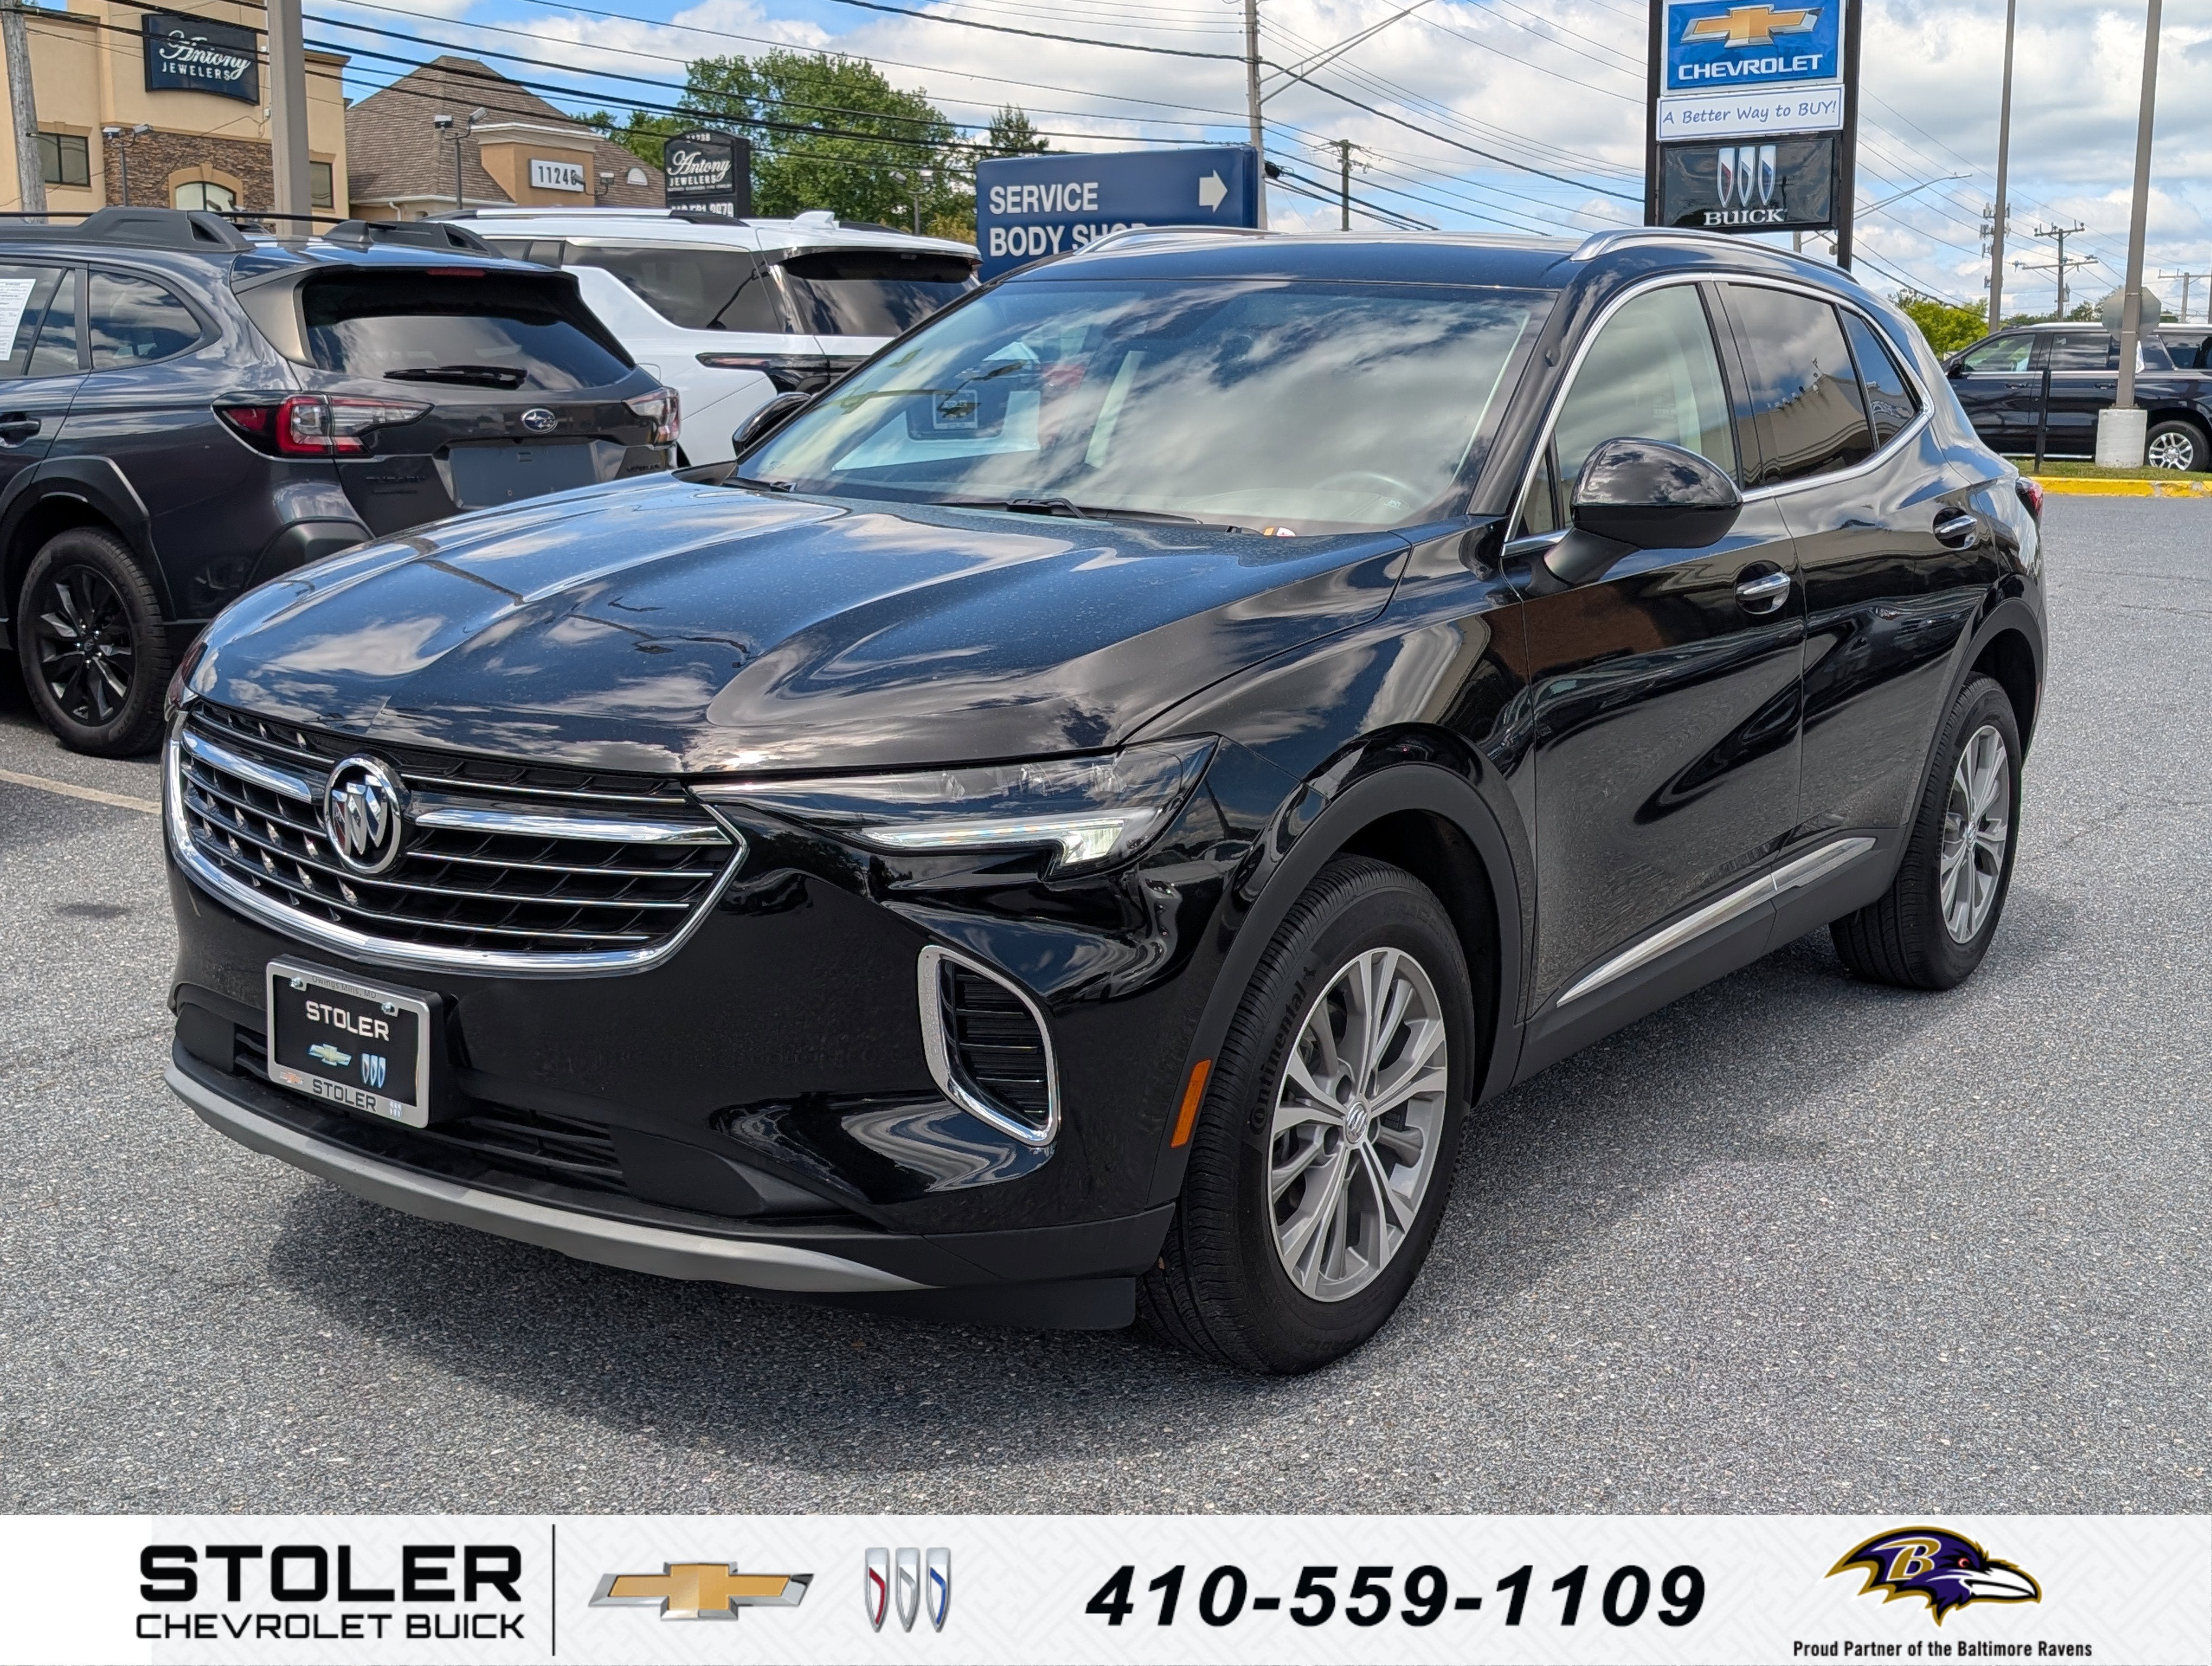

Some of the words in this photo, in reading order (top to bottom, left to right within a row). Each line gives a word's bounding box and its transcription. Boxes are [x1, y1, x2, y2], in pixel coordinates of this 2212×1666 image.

[162, 62, 231, 81] JEWELERS
[1679, 54, 1823, 80] CHEVROLET
[1663, 111, 1674, 124] A
[1682, 110, 1731, 124] Better
[1737, 106, 1769, 123] Way
[1776, 105, 1791, 117] to
[1798, 100, 1836, 116] BUY!
[667, 150, 731, 182] Antony
[669, 174, 717, 187] JEWELERS
[989, 182, 1099, 215] SERVICE
[1703, 208, 1786, 226] BUICK
[990, 225, 1065, 257] BODY
[1072, 223, 1148, 250] SH
[312, 976, 340, 990] Owings
[364, 989, 377, 998] MD
[305, 1001, 390, 1041] STOLER
[1249, 980, 1308, 1135] Continental
[312, 1079, 377, 1112] STOLER
